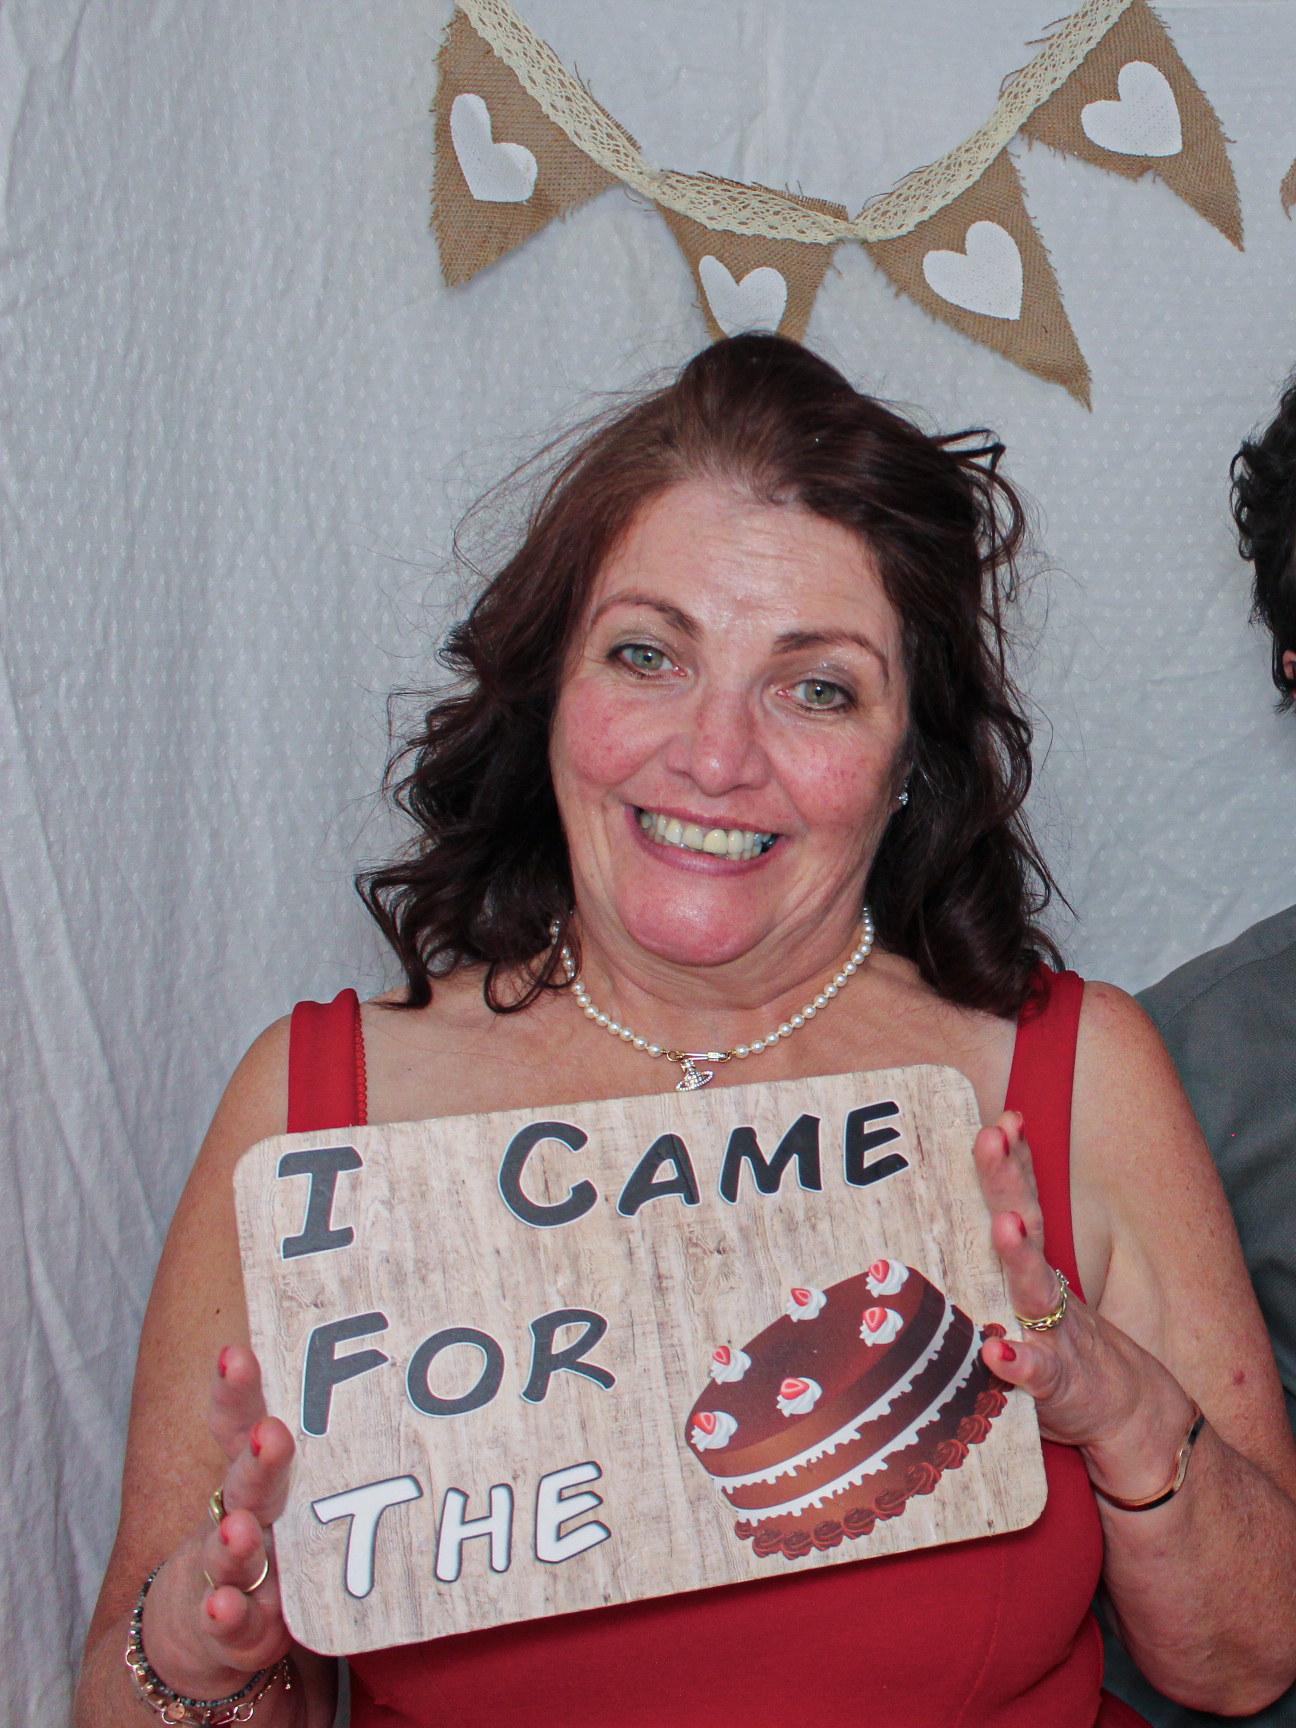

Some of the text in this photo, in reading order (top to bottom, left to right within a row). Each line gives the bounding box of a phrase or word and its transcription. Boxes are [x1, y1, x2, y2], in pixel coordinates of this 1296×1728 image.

[277, 1100, 909, 1259] I CAME
[301, 1307, 616, 1438] FOR
[312, 1461, 611, 1598] THE
